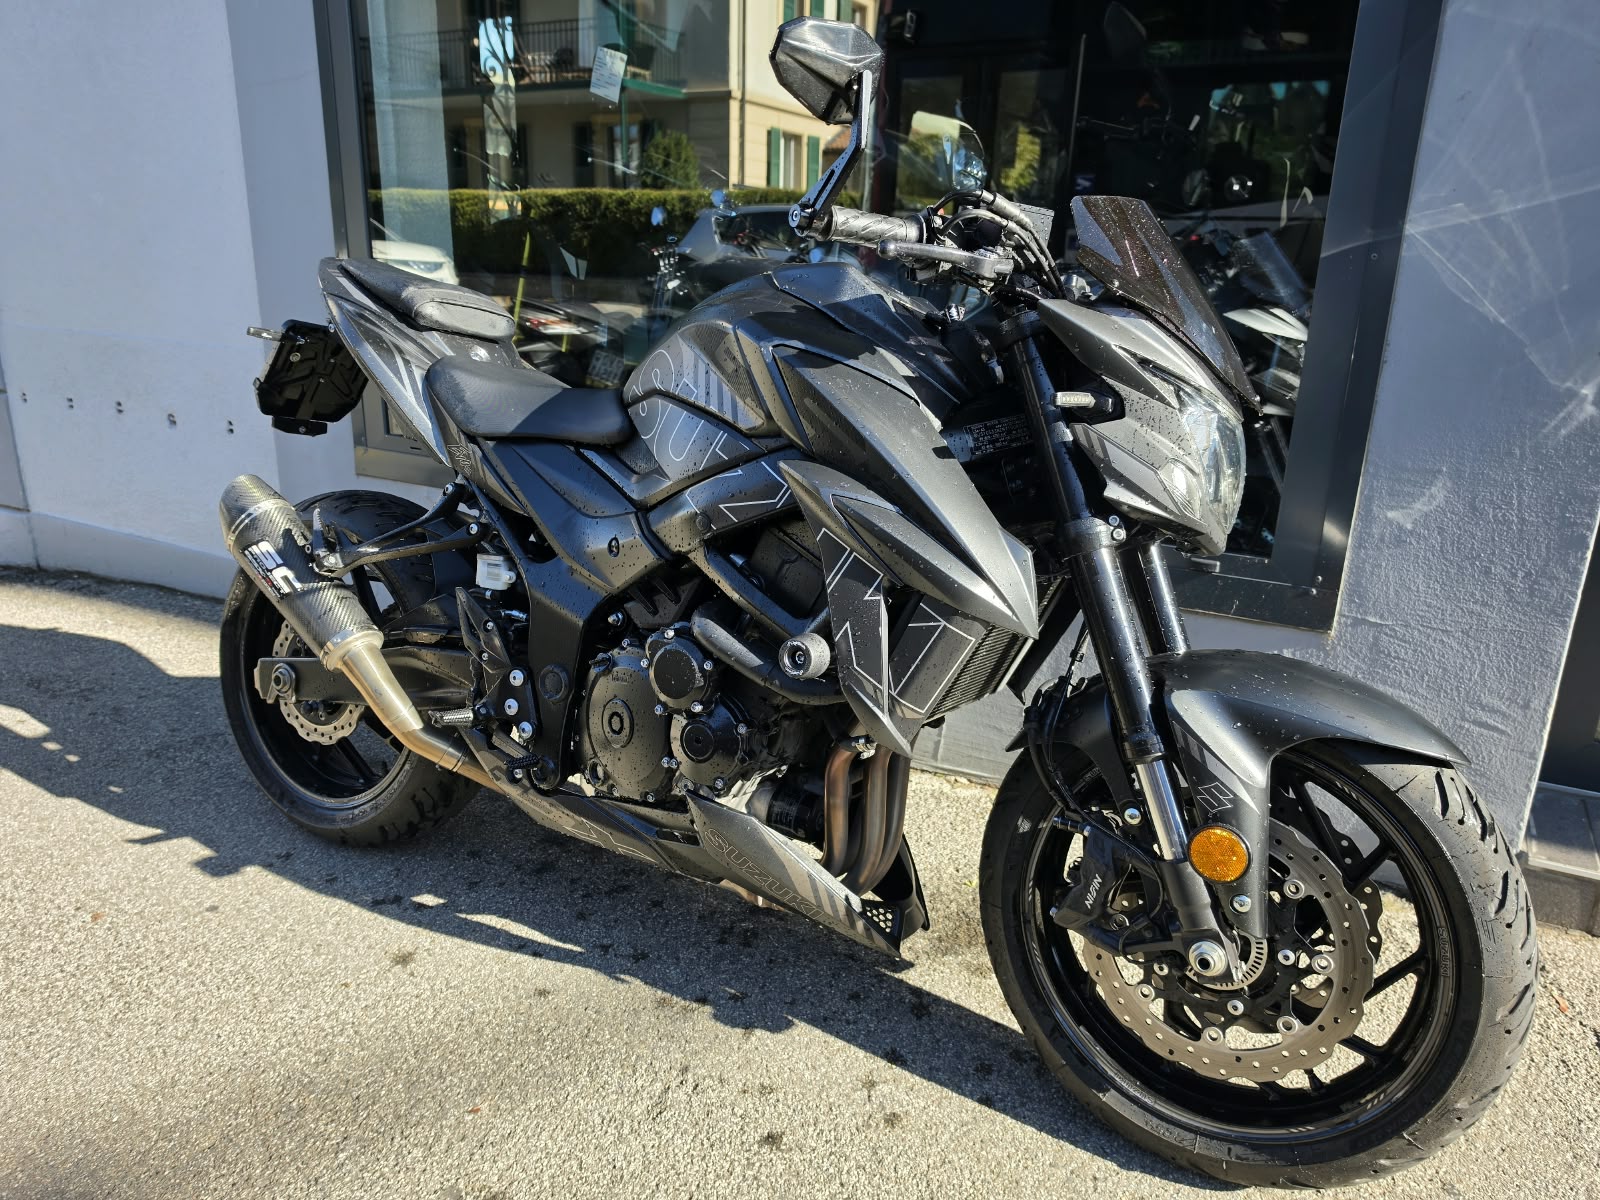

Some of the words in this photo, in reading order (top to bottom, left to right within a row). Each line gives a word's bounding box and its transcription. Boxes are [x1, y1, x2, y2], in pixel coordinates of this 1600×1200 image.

[250, 540, 304, 595] SC
[704, 828, 825, 920] SUZUKI
[1437, 927, 1450, 977] SUZUKI
